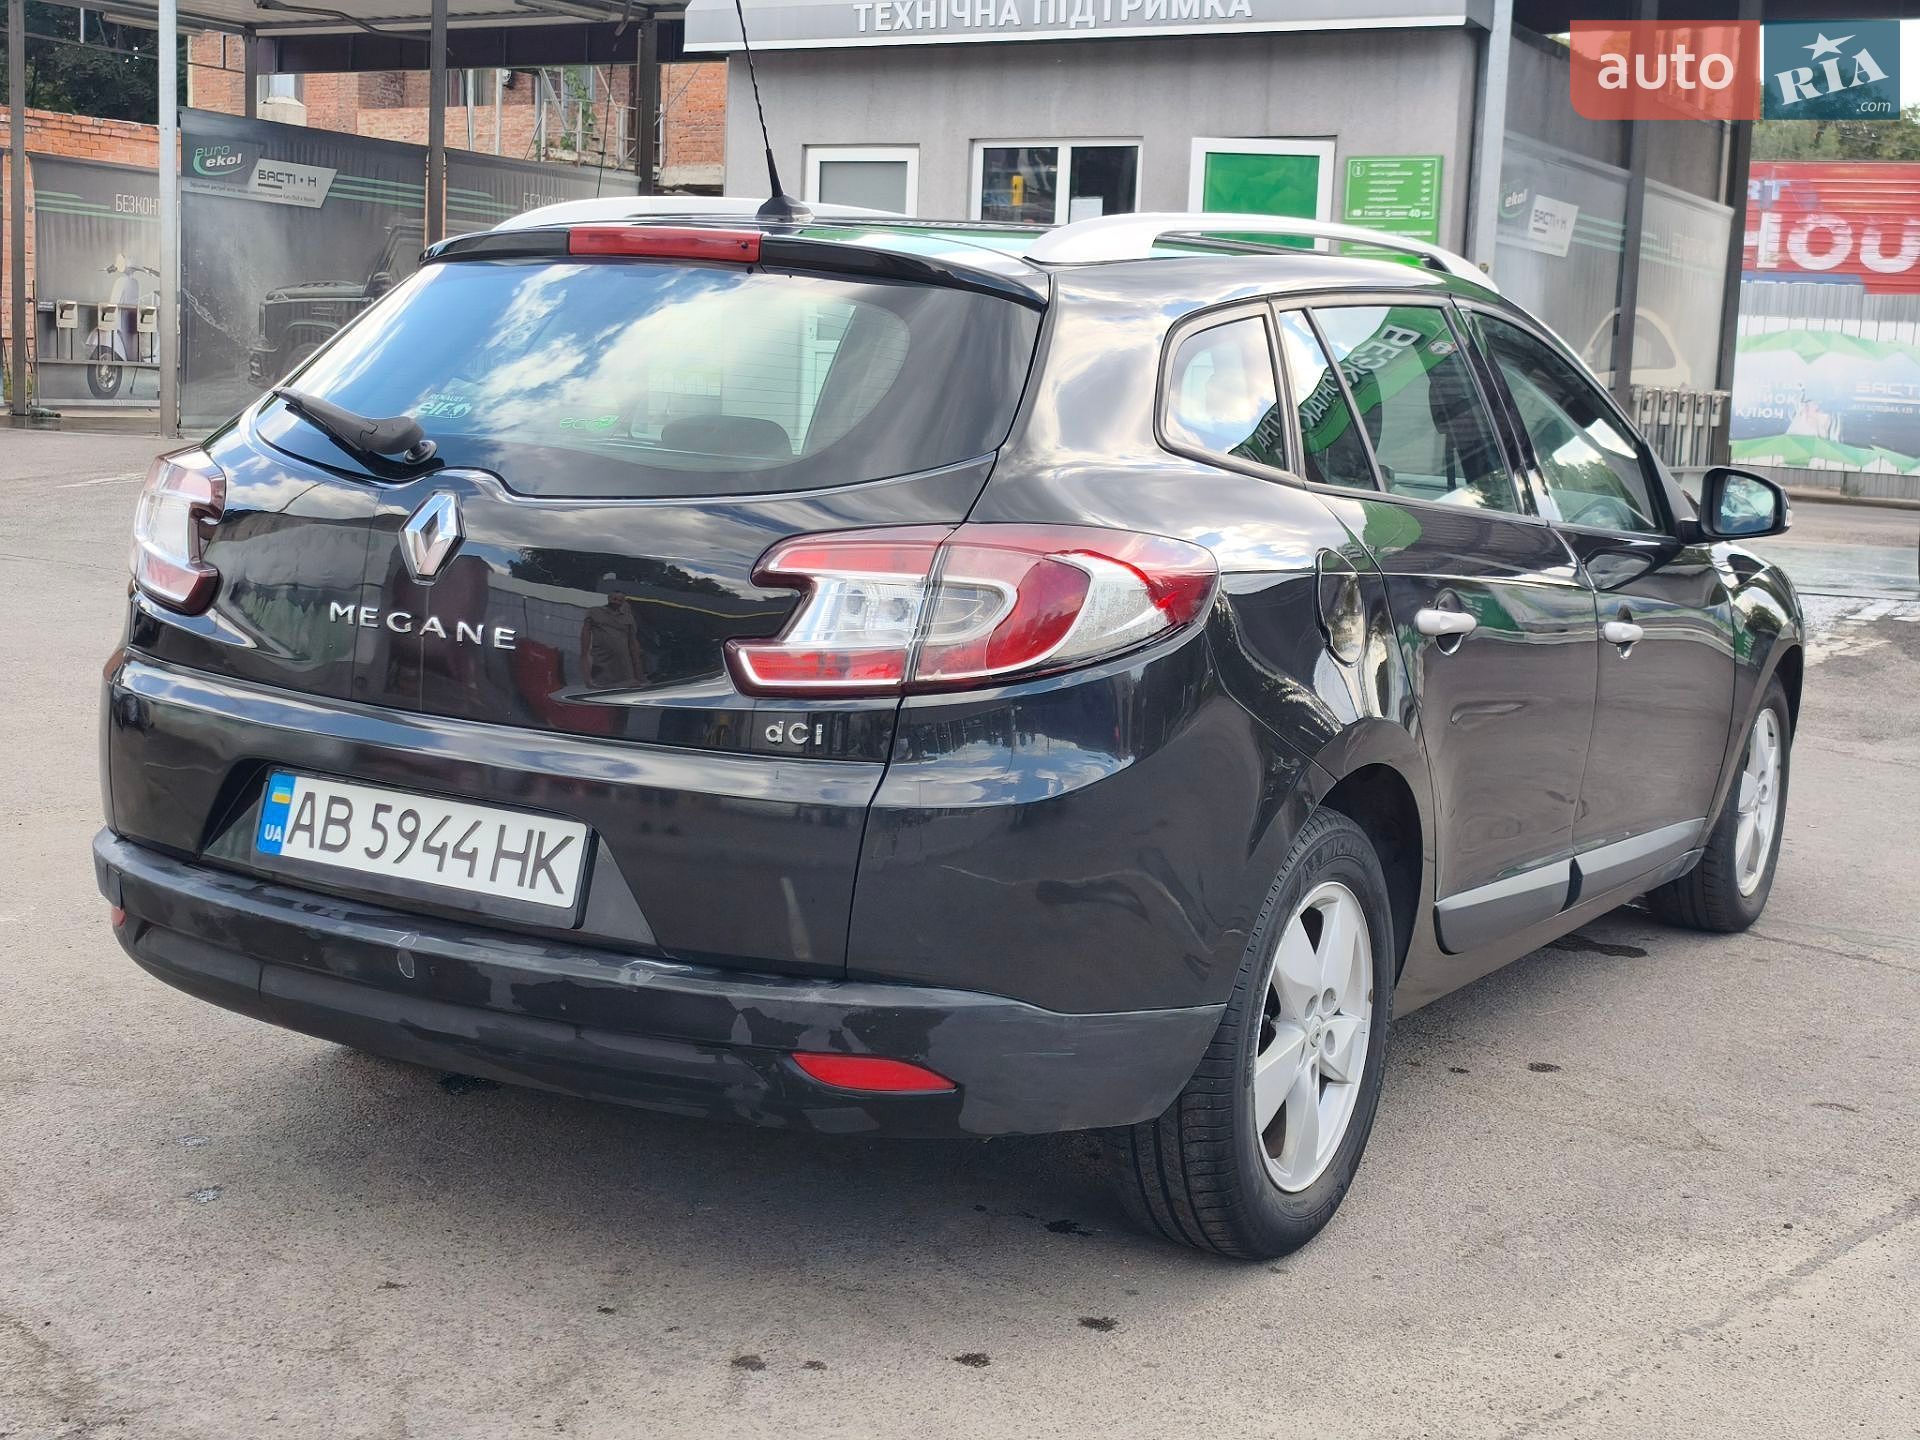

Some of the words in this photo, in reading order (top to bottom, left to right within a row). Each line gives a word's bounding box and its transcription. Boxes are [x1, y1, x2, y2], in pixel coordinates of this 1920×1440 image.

[853, 0, 1021, 32] ТЕХНІЧНА
[195, 144, 231, 157] euro
[206, 152, 243, 168] ekol
[329, 601, 516, 650] MEGANE
[264, 823, 282, 843] UA
[286, 791, 354, 855] AB
[364, 803, 483, 879] 5944
[489, 824, 576, 895] HK
